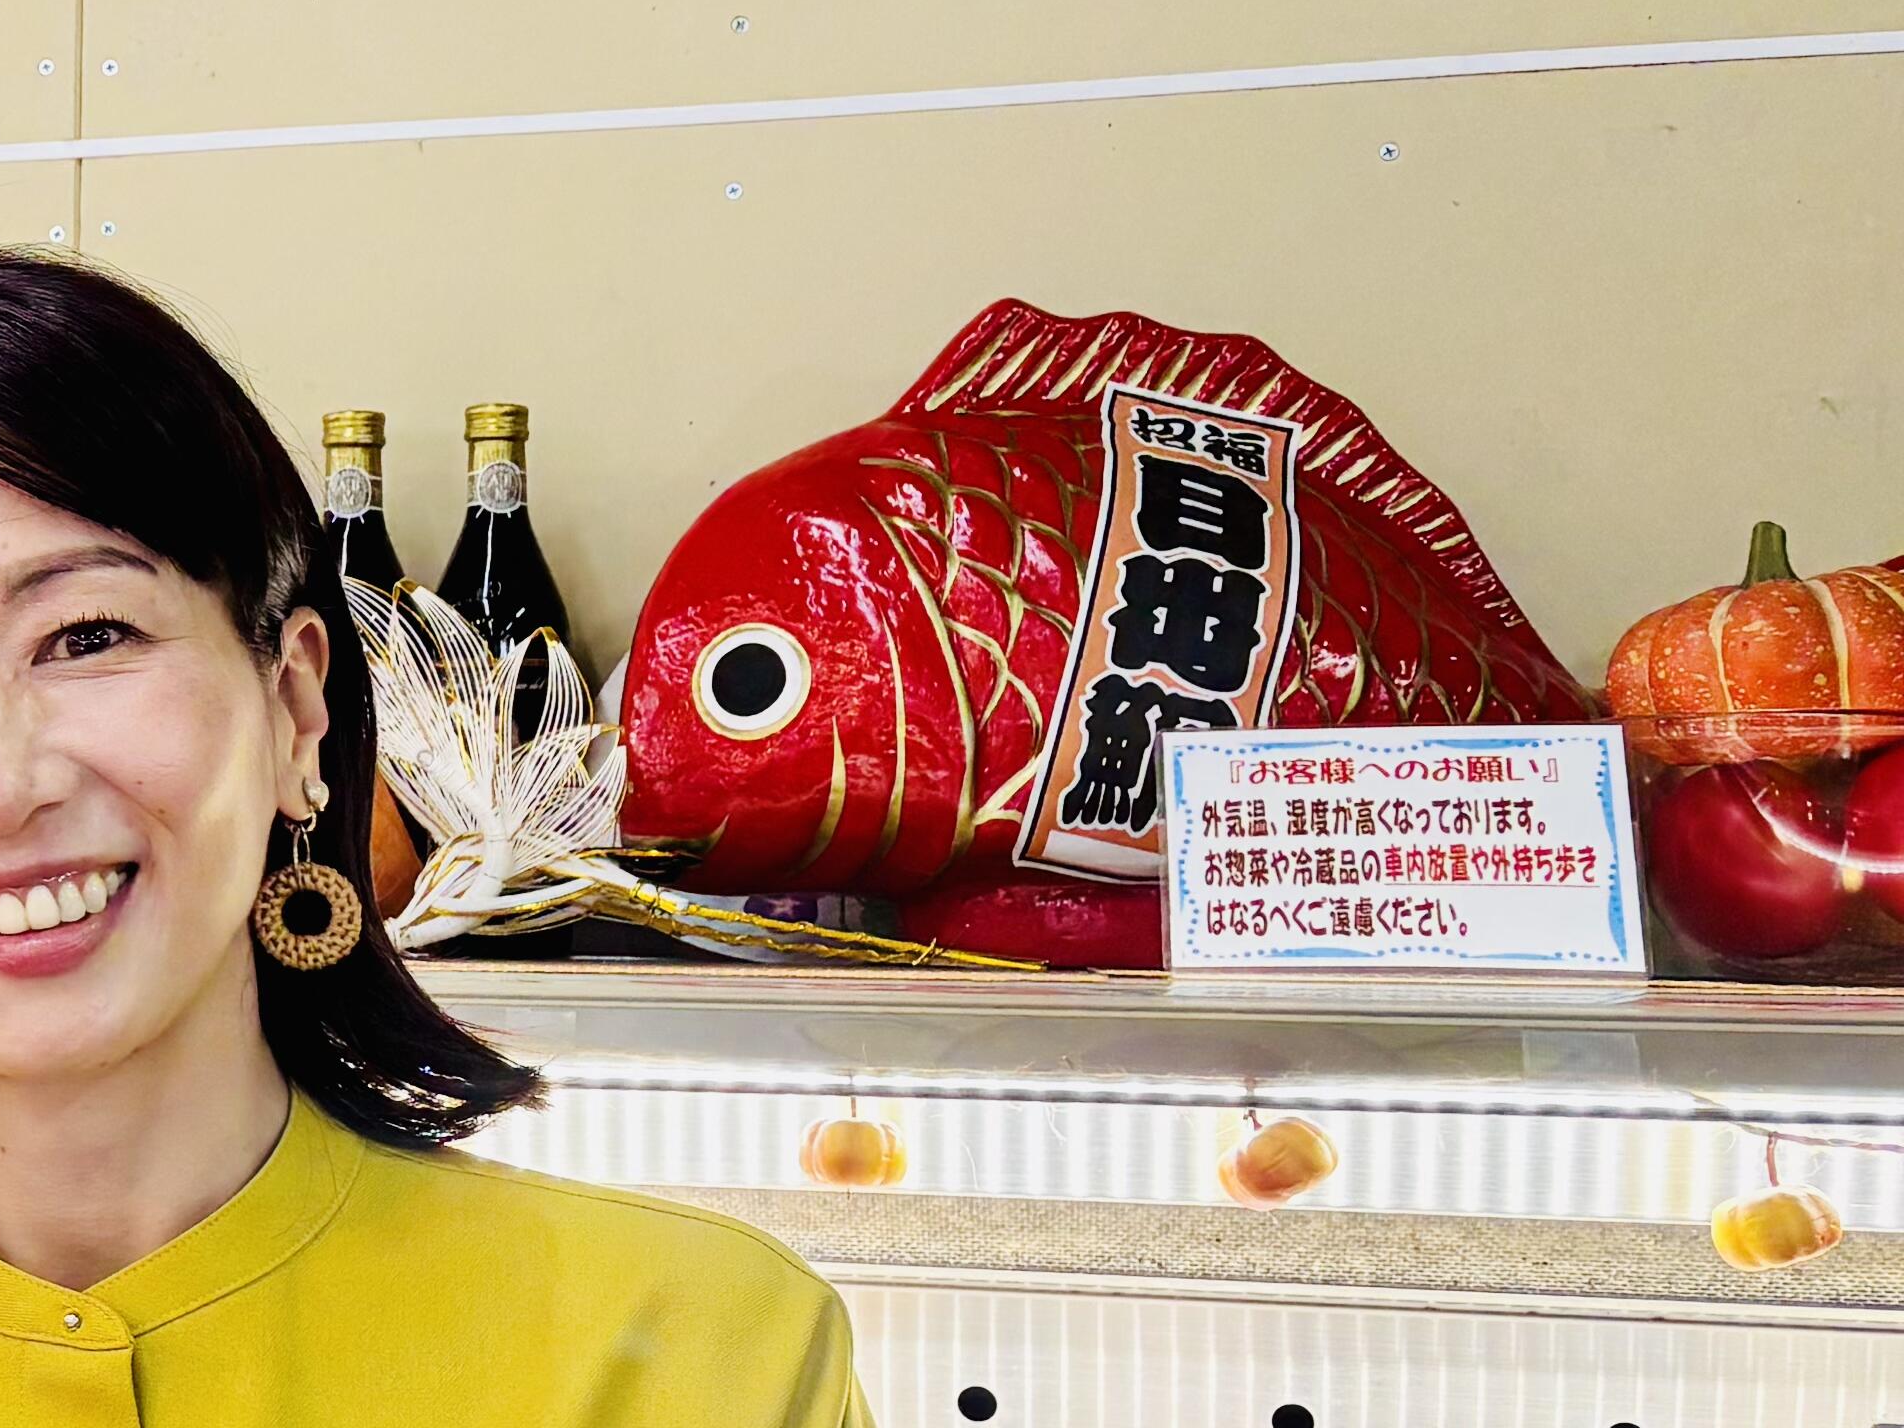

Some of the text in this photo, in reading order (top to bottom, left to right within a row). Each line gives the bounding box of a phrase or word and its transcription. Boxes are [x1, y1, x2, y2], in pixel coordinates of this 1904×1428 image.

[1130, 408, 1268, 479] 招福
[1059, 453, 1272, 833] 目出鯛
[1229, 755, 1560, 785] 『お客様へのお願い』
[1202, 798, 1547, 837] 外気温、湿度が高くなっております。
[1204, 843, 1597, 886] お惣菜や冷蔵品の車内放置や外持ち歩き
[1206, 896, 1469, 937] はなるべくご遠慮ください。
